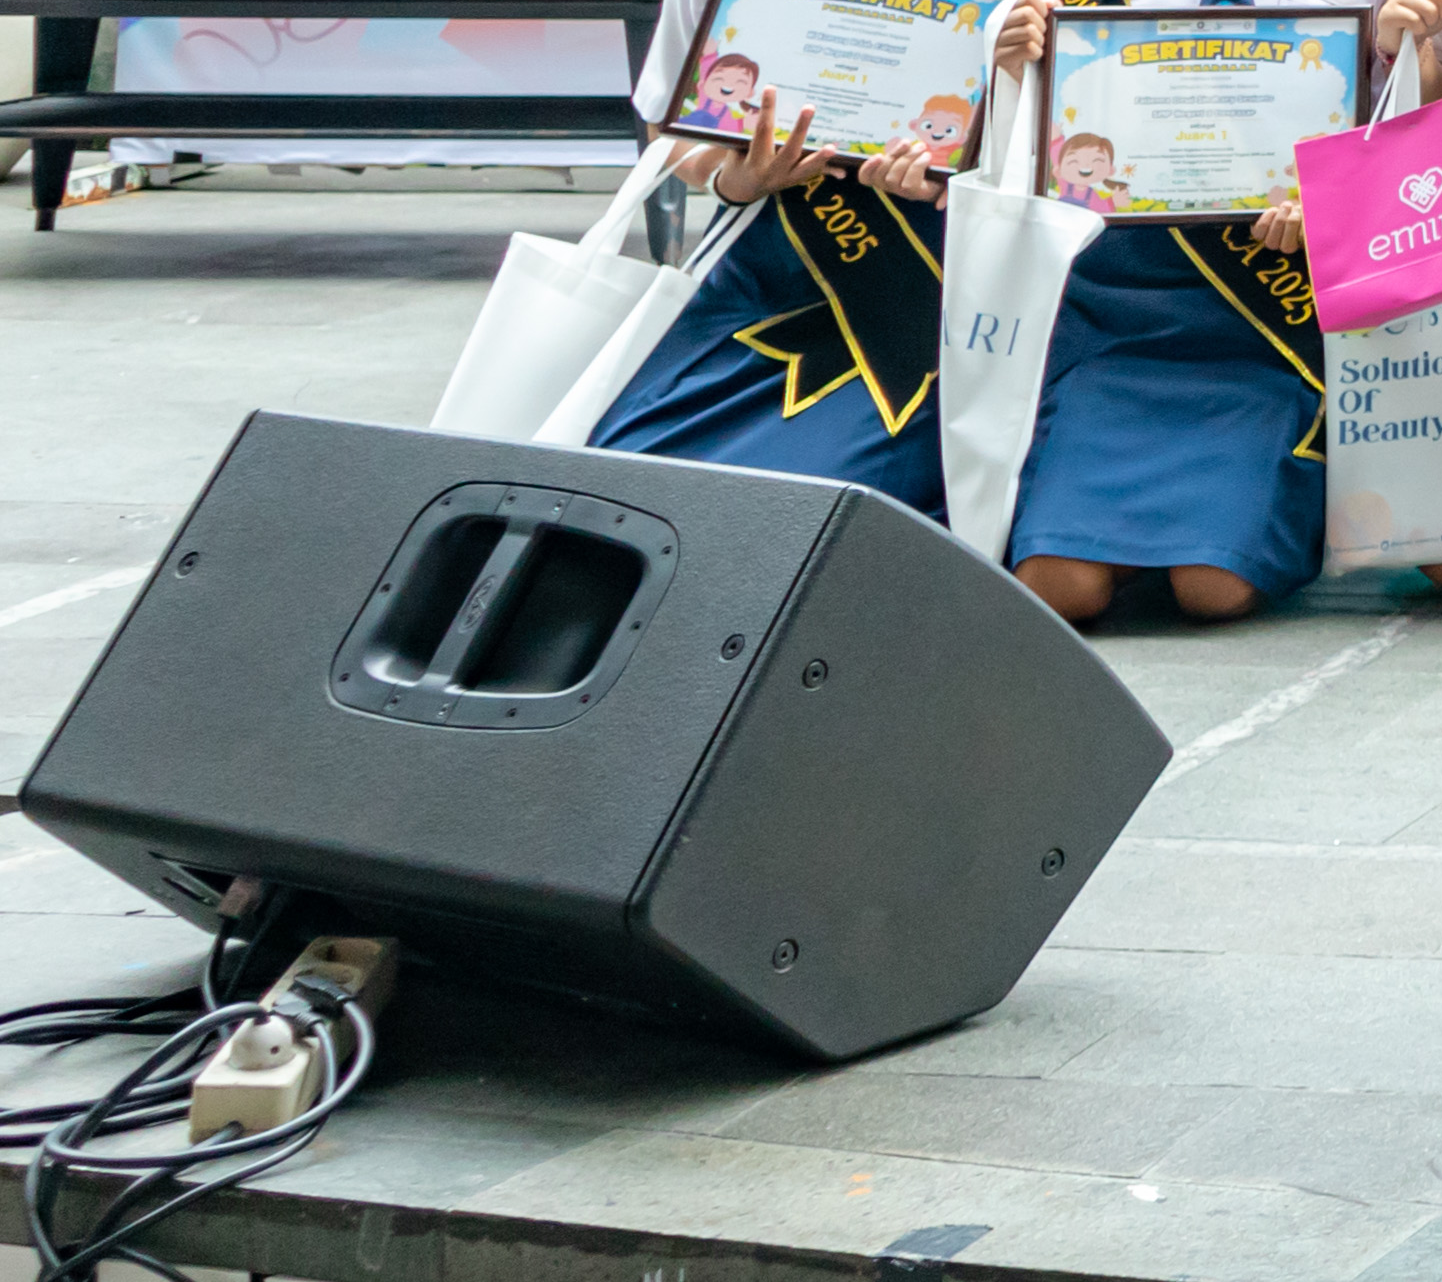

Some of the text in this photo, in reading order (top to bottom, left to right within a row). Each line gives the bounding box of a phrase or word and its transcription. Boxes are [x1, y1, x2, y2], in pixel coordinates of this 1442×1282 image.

[1120, 38, 1293, 66] SERTIFIKAT
[813, 193, 879, 263] 2025
[1255, 256, 1317, 325] 2025
[1339, 387, 1379, 415] Of
